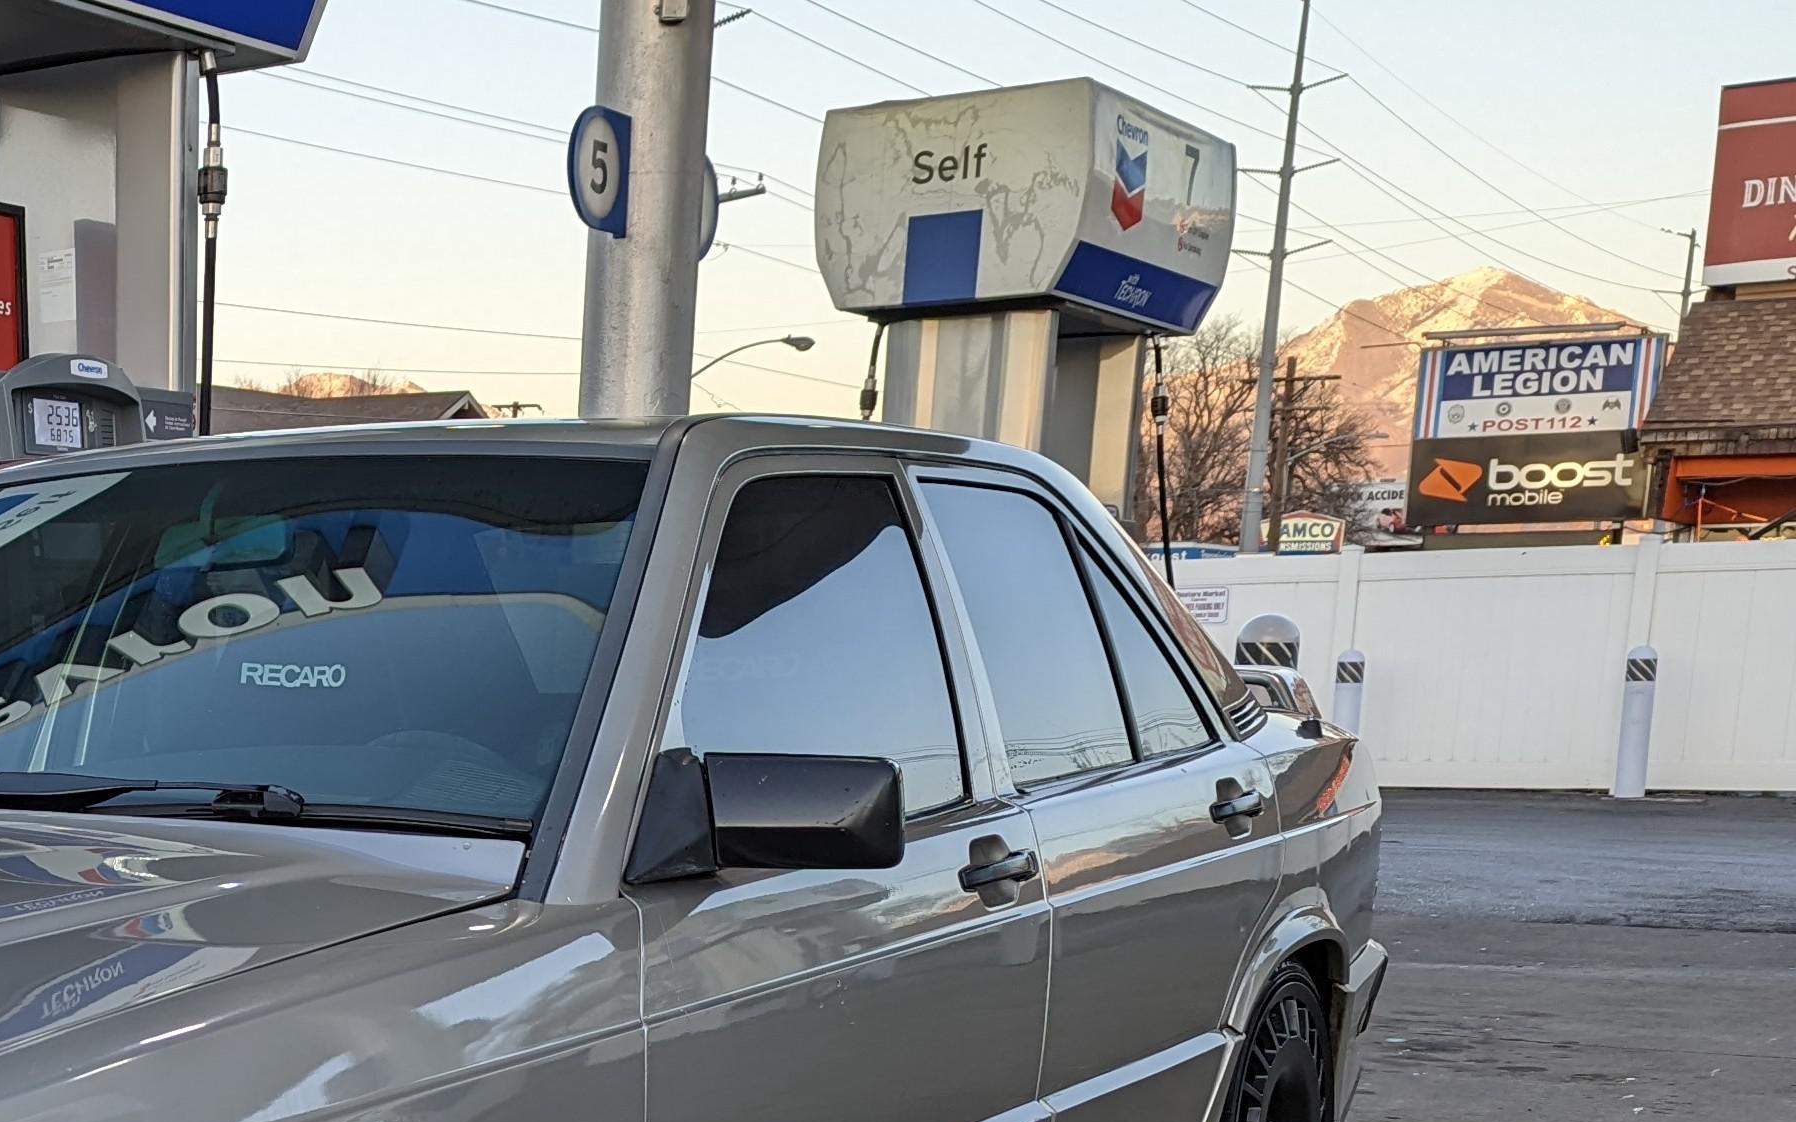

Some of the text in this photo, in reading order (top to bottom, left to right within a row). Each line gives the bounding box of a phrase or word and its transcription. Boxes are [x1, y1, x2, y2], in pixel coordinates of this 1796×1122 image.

[1116, 114, 1149, 145] Chevron
[590, 139, 608, 195] 5
[911, 143, 988, 184] Self
[1185, 144, 1200, 206] 7
[1114, 280, 1152, 308] TECHRON
[78, 362, 103, 374] Chevron
[1446, 343, 1635, 376] AMERICAN
[1472, 368, 1604, 397] LEGION
[1488, 453, 1634, 490] boost
[1367, 490, 1404, 500] ACCIDE
[1487, 489, 1563, 506] mobile
[1280, 522, 1334, 538] AMCO
[1281, 541, 1332, 552] NSMISSIONS
[240, 662, 345, 687] RECARO
